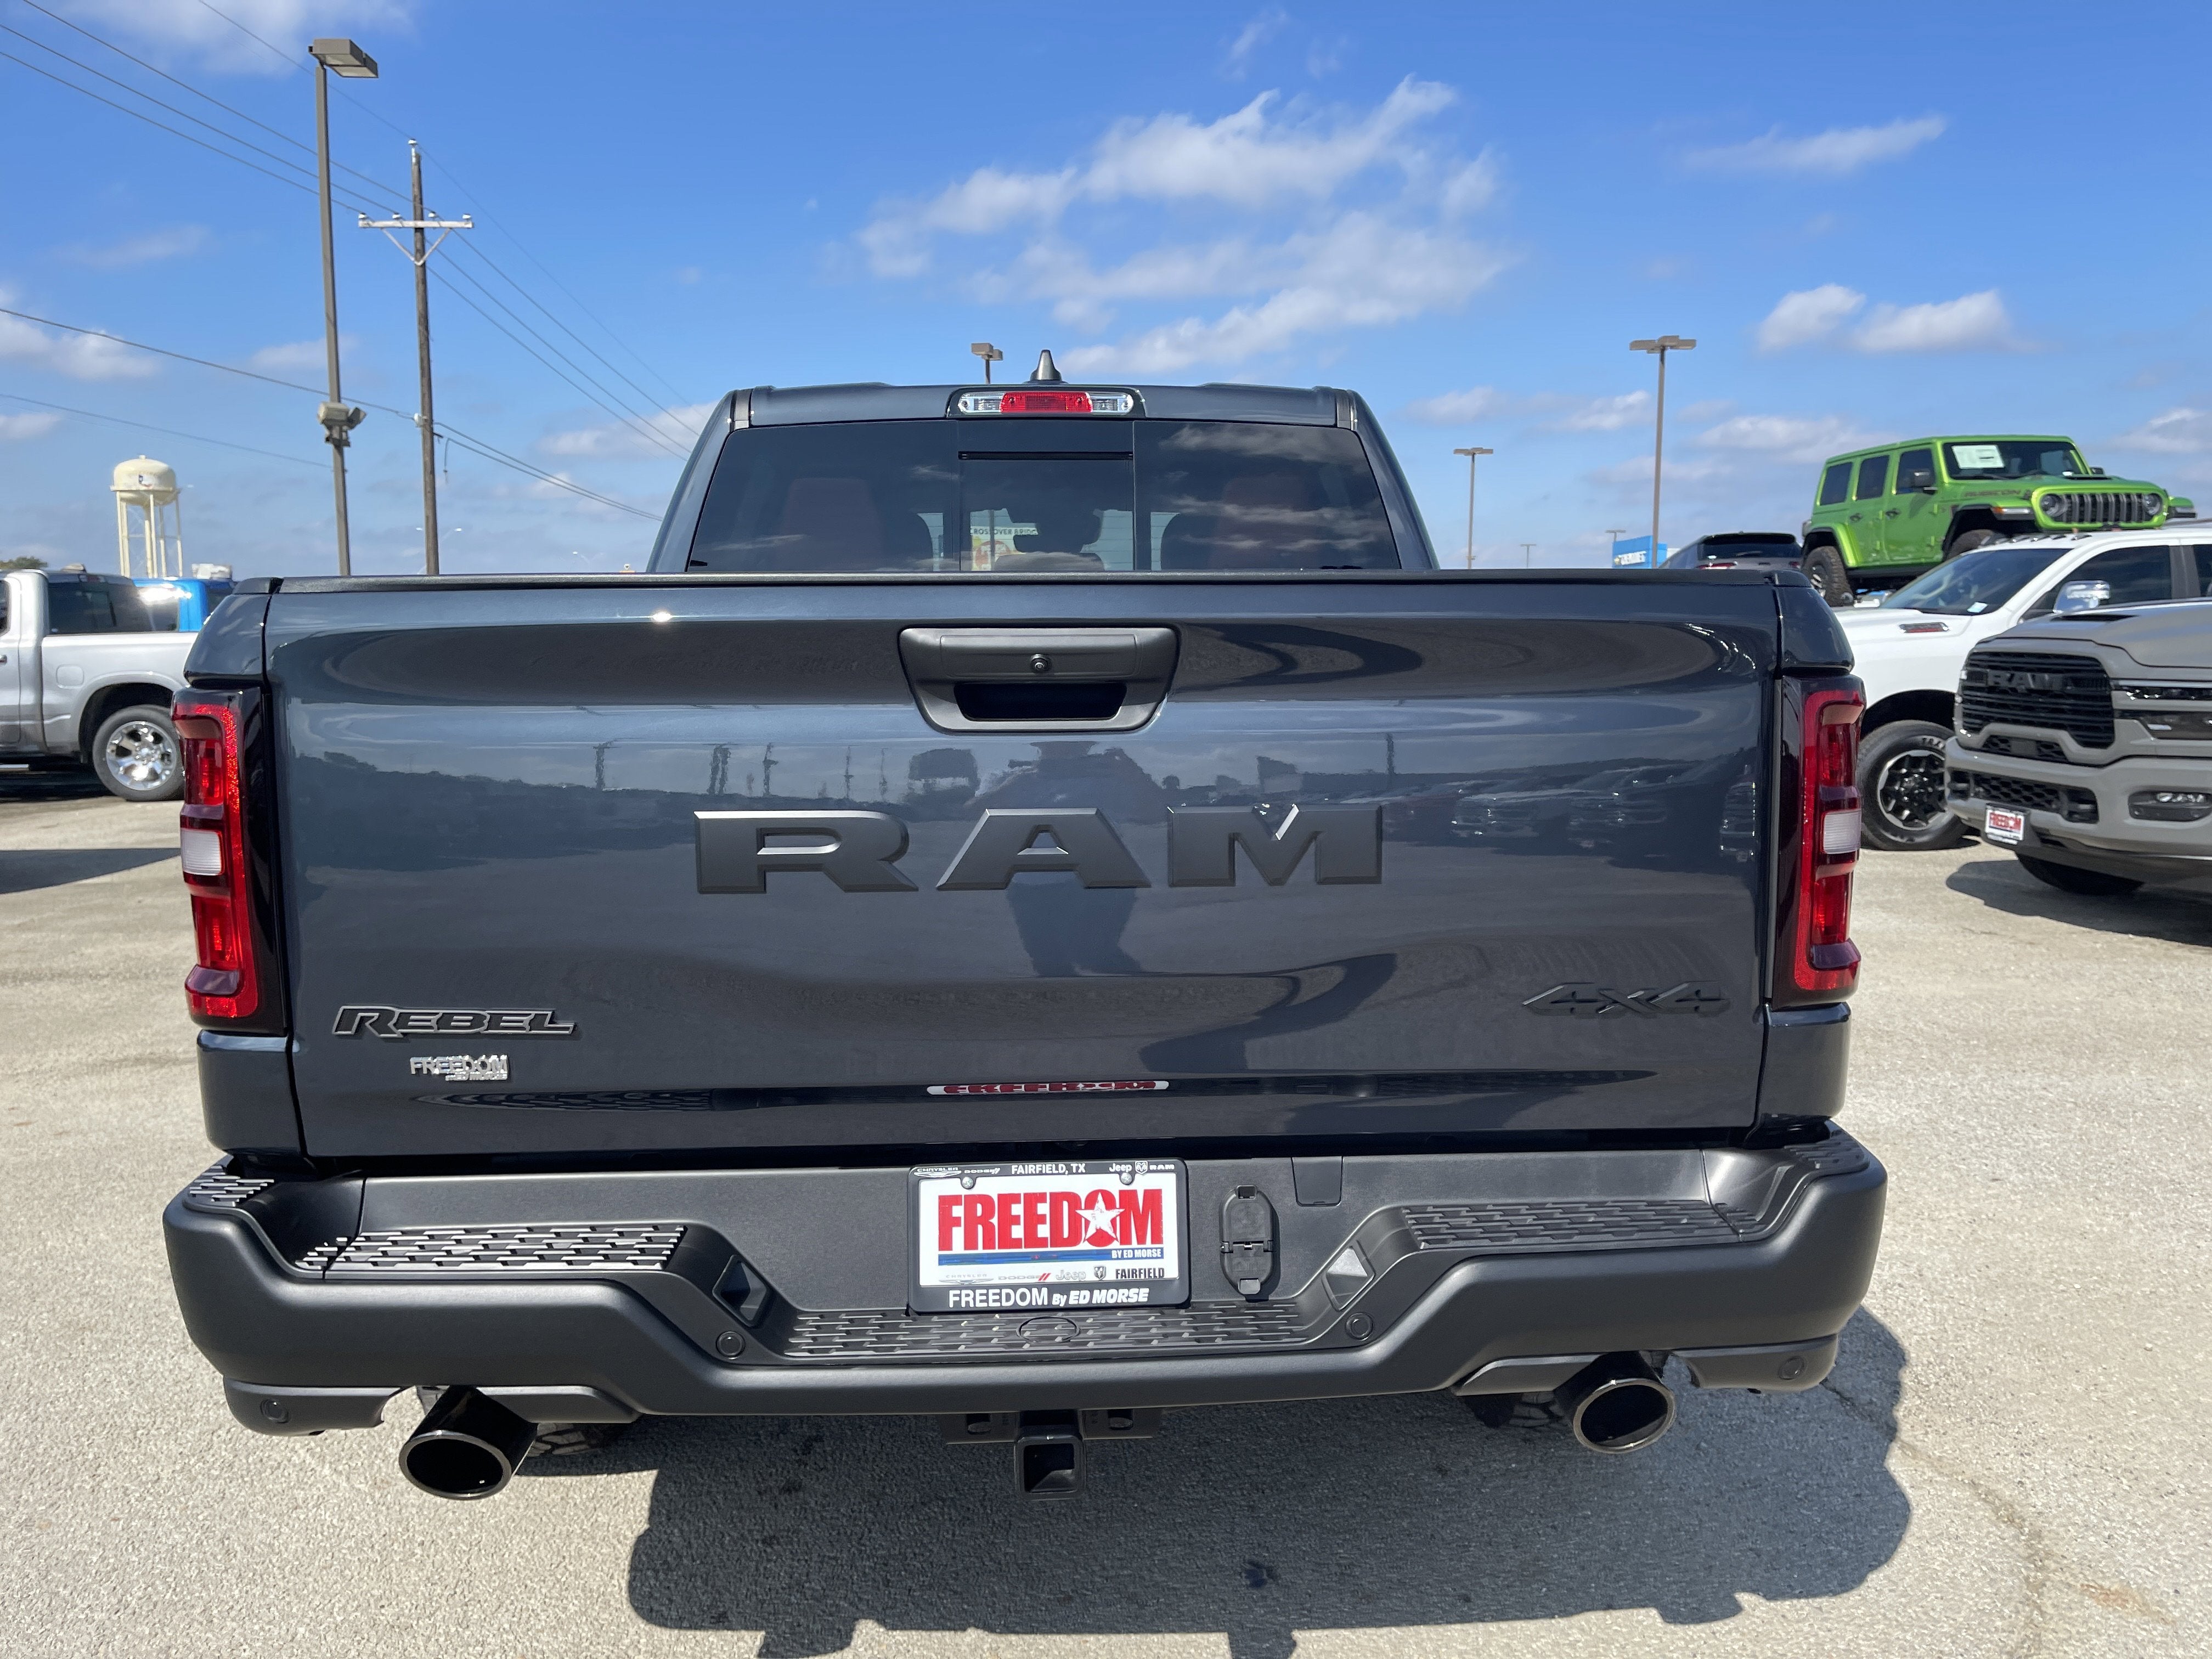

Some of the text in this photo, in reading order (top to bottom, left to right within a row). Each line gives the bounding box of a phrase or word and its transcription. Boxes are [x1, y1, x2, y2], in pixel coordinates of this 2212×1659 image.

[693, 805, 1383, 894] RAM
[332, 1005, 576, 1038] REBEL
[410, 1054, 509, 1075] FREEDOM
[1011, 1163, 1086, 1175] FAIRFIELD, TX
[1109, 1163, 1132, 1173] Jeep
[938, 1189, 1163, 1251] FREEDOM
[1111, 1248, 1161, 1259] BY ED MORSE
[1056, 1269, 1086, 1282] Jeep
[1115, 1267, 1165, 1279] FAIRFIELD
[949, 1287, 1149, 1308] FREEDOM By ED MORSE
